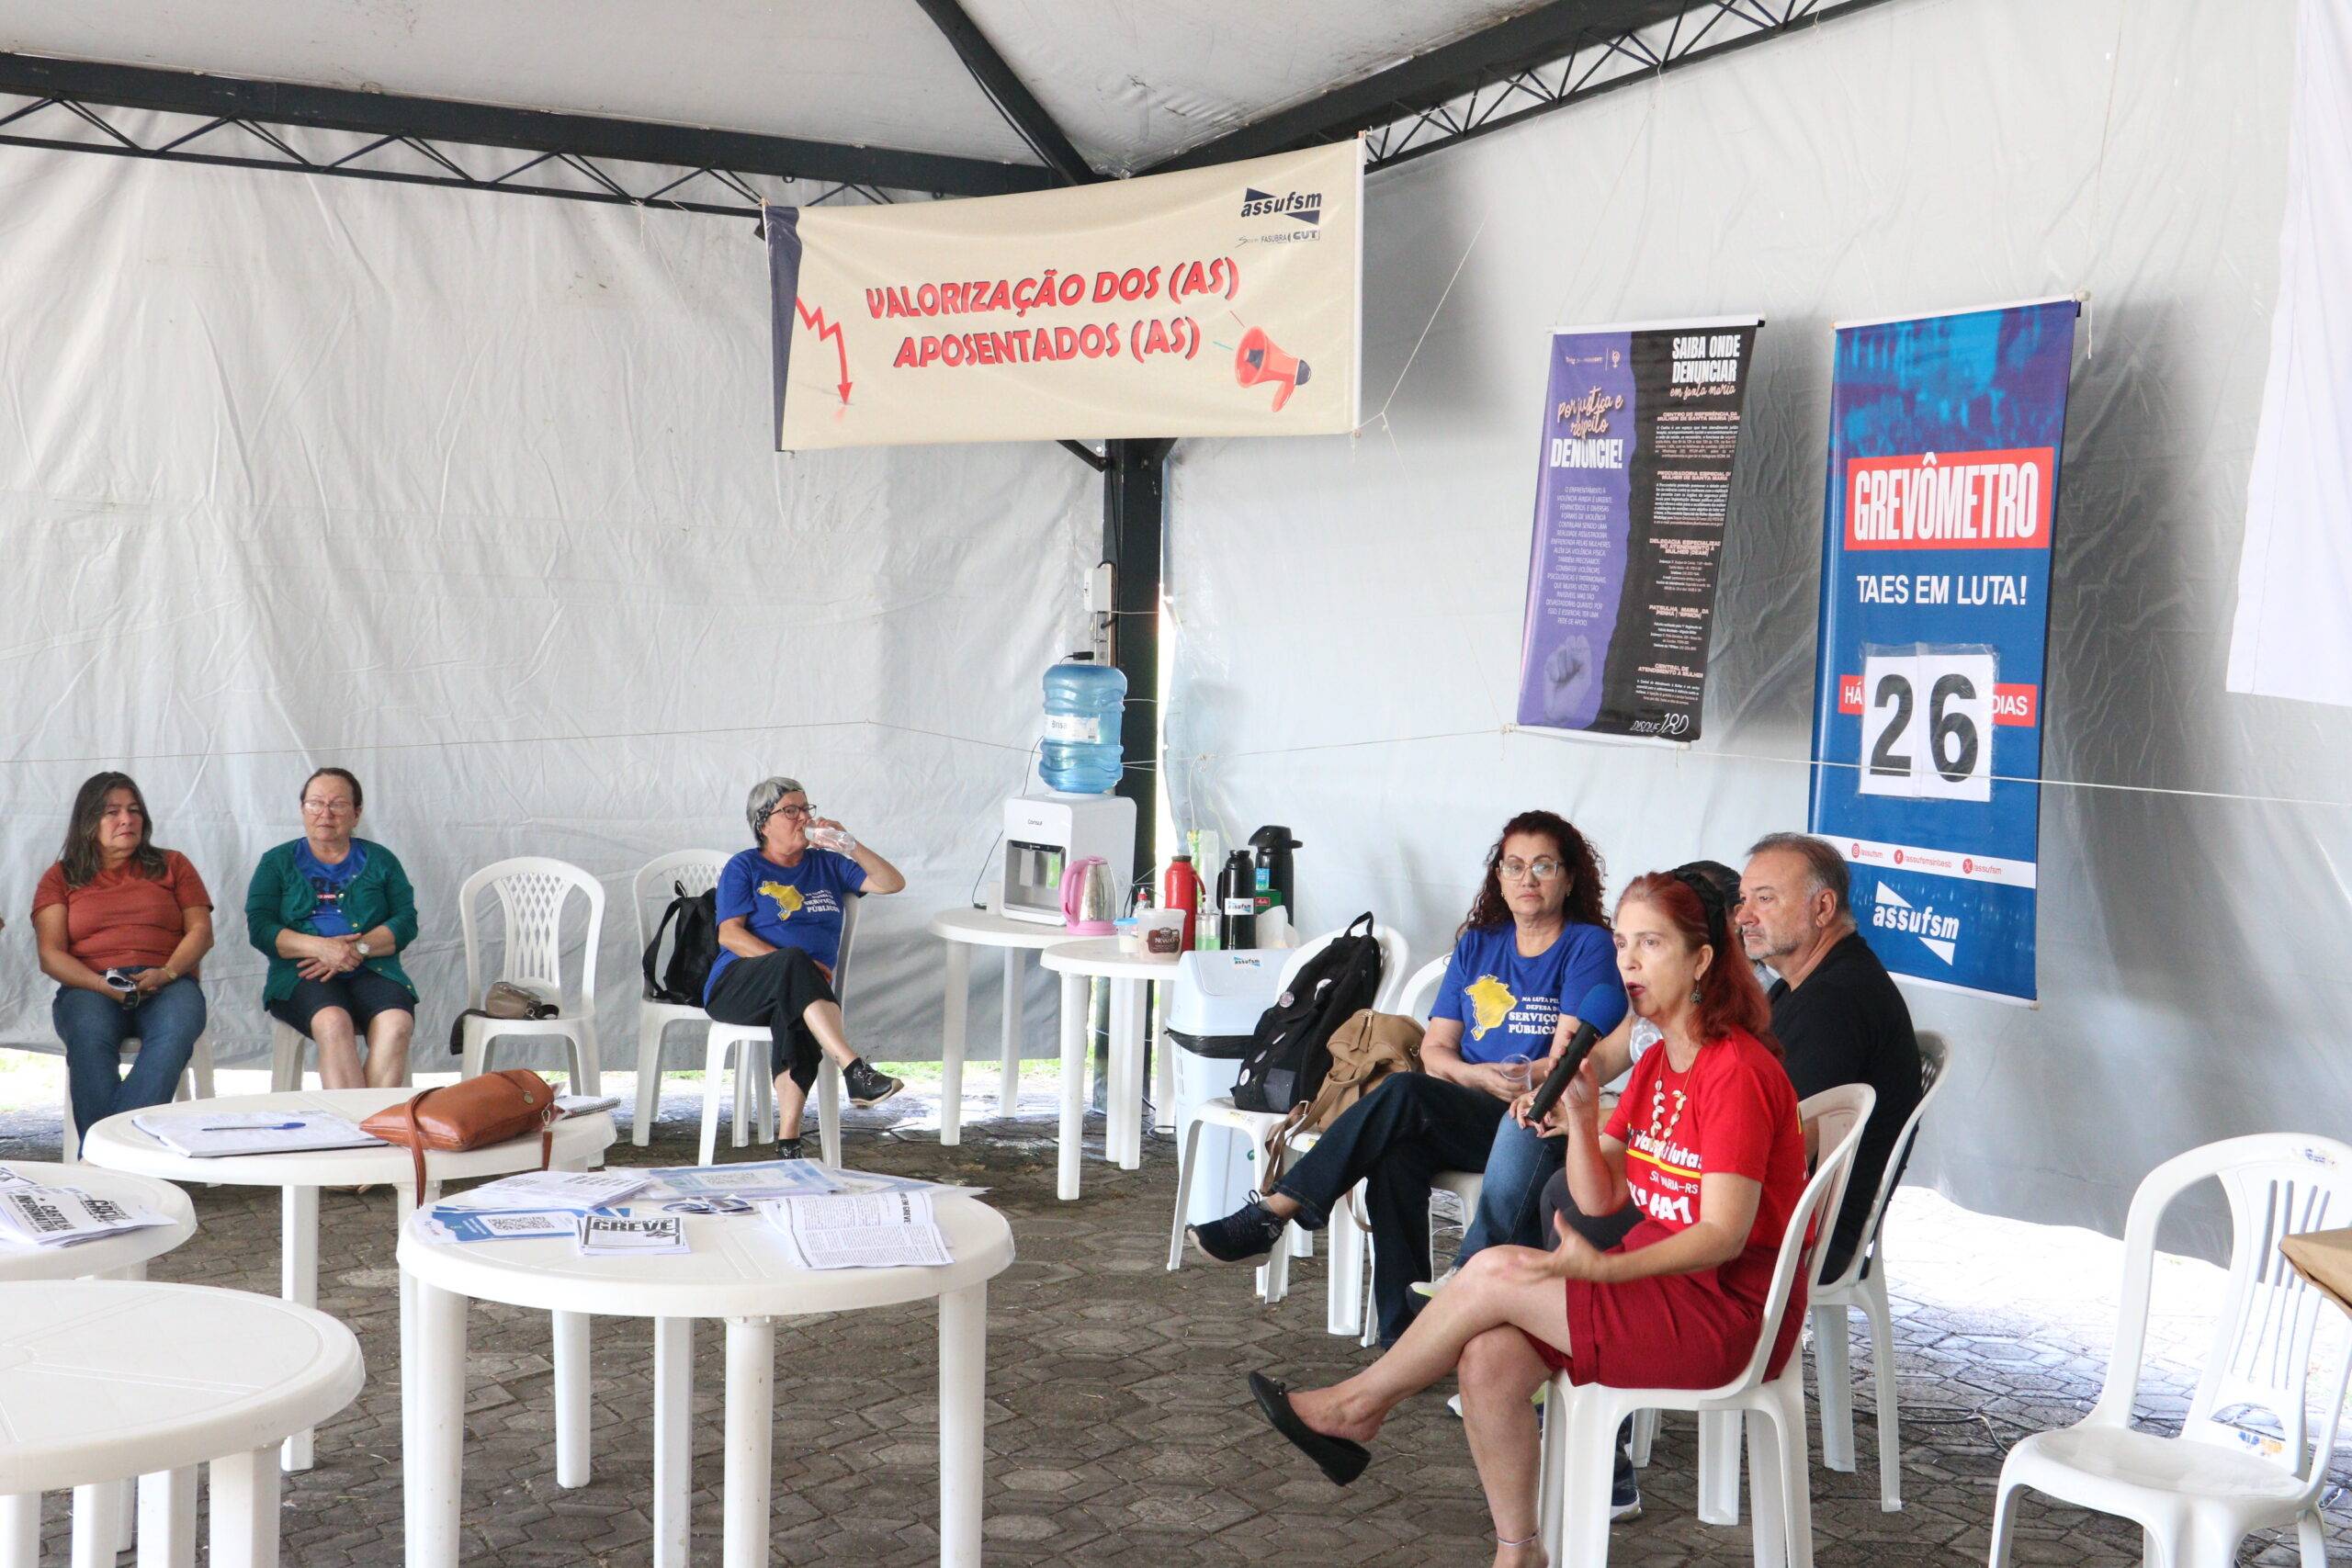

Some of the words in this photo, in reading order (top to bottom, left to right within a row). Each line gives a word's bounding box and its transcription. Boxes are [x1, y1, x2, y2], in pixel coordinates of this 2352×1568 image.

[1240, 191, 1322, 218] assufsm
[1261, 234, 1287, 243] FASUBRA
[1293, 230, 1317, 240] CUT
[865, 267, 1086, 319] VALORIZAÇÃO
[1092, 265, 1161, 304] DOS
[1170, 257, 1239, 305] (AS)
[893, 322, 1121, 368] APOSENTADOS
[1131, 316, 1201, 365] (AS)
[1672, 335, 1706, 359] SAIBA
[1709, 333, 1741, 358] ONDE
[1672, 359, 1737, 383] DENUNCIAR
[1669, 387, 1683, 398] em
[1557, 399, 1577, 423] por
[1615, 395, 1624, 409] e
[1550, 438, 1623, 469] DENUNCIE!
[1854, 451, 2040, 542] GREVÔMETRO
[1856, 575, 1909, 604] TAES
[1915, 575, 1950, 604] EM
[1957, 575, 2028, 605] LUTA!
[1630, 720, 1661, 732] DISQUE
[1845, 681, 1863, 705] HÁ
[1869, 672, 1979, 783] 26
[1873, 905, 1960, 940] assufsm
[1509, 1011, 1558, 1025] SERVIÇO
[593, 1221, 675, 1232] GREVE
